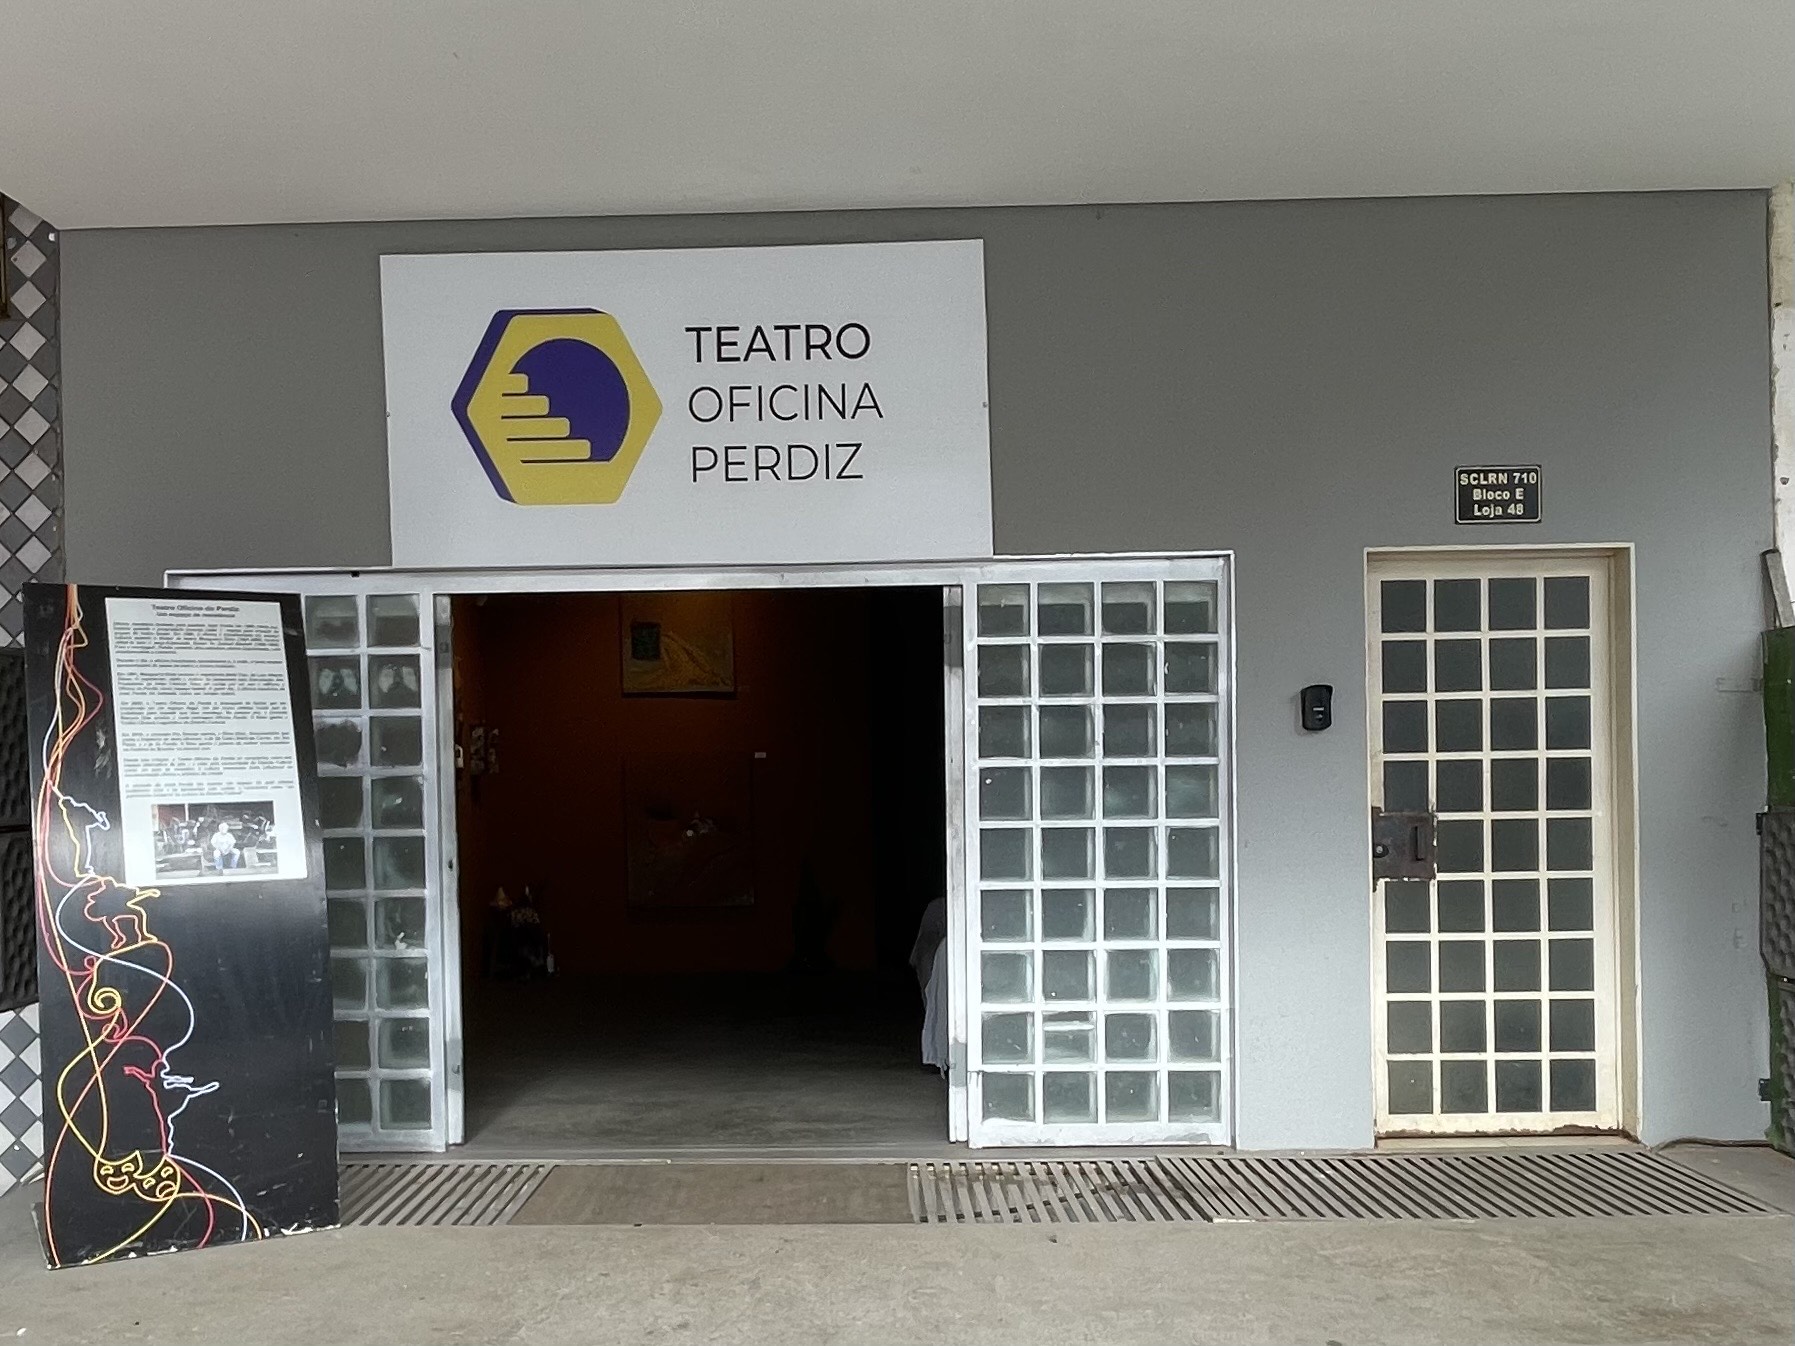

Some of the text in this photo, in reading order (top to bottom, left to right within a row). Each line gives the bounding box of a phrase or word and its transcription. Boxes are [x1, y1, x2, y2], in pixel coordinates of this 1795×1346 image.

[685, 323, 870, 363] TEATRO
[689, 383, 884, 423] OFICINA
[693, 443, 863, 483] PERDIZ
[1460, 472, 1536, 485] SCLRN 710
[1473, 488, 1524, 500] Bloco E
[1473, 503, 1523, 518] Loja 48
